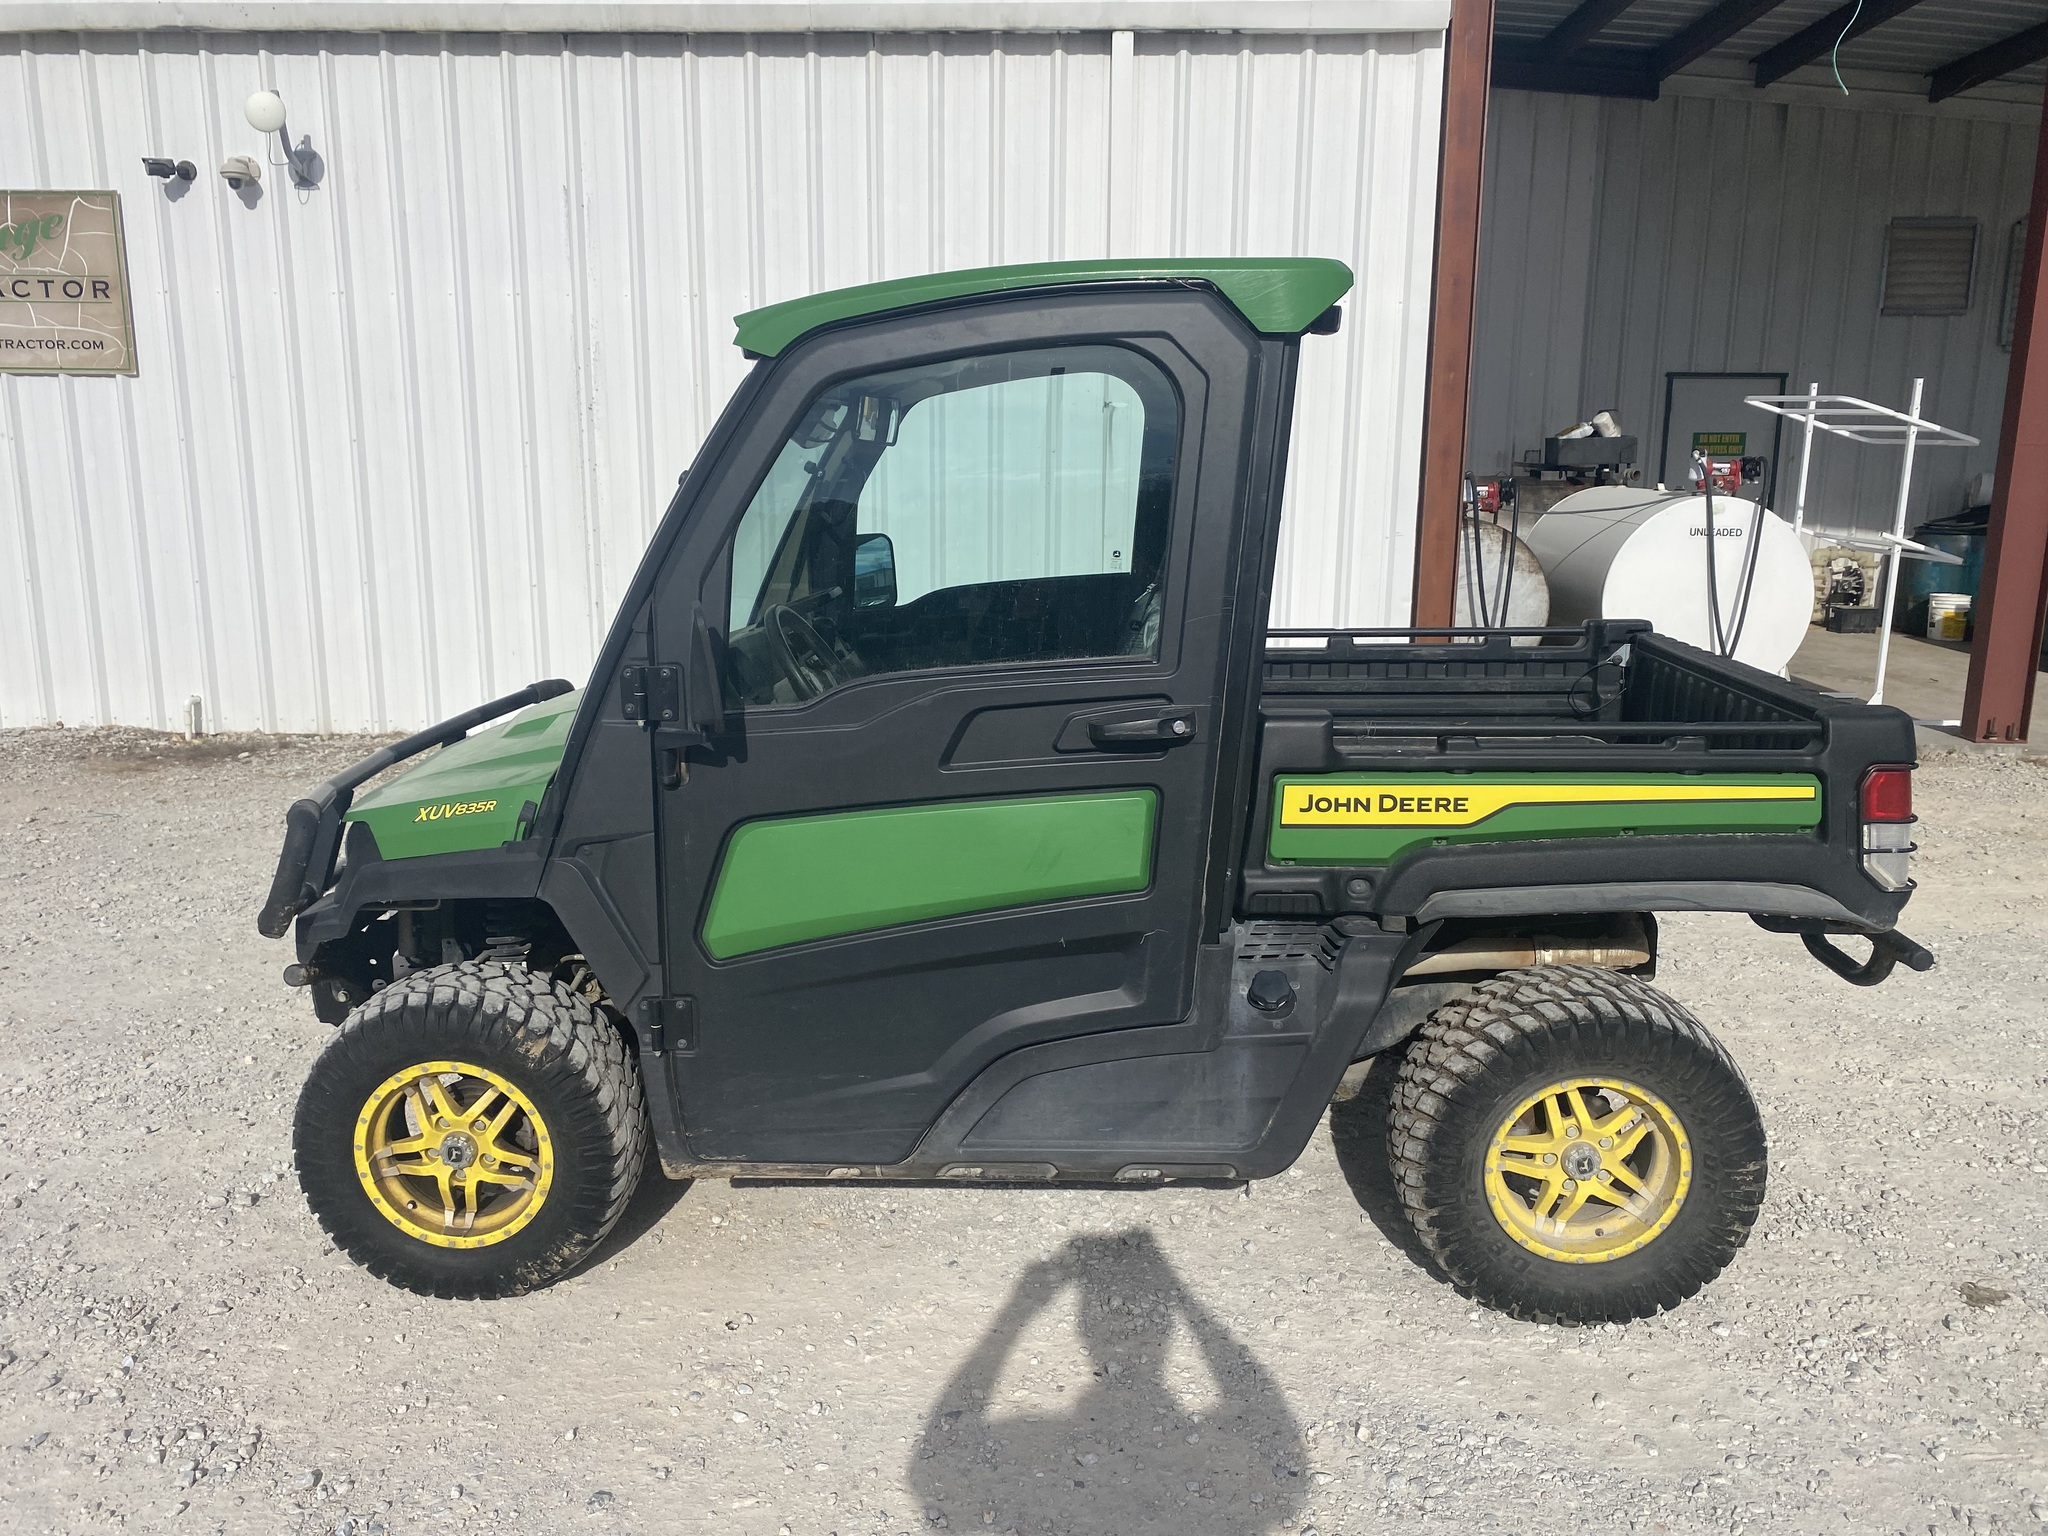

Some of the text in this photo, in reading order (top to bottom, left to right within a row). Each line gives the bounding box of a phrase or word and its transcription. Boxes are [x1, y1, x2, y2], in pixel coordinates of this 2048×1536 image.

[1690, 527, 1743, 537] UNLADED
[412, 799, 498, 823] XUV835R
[1299, 794, 1469, 813] JOHN DEERE
